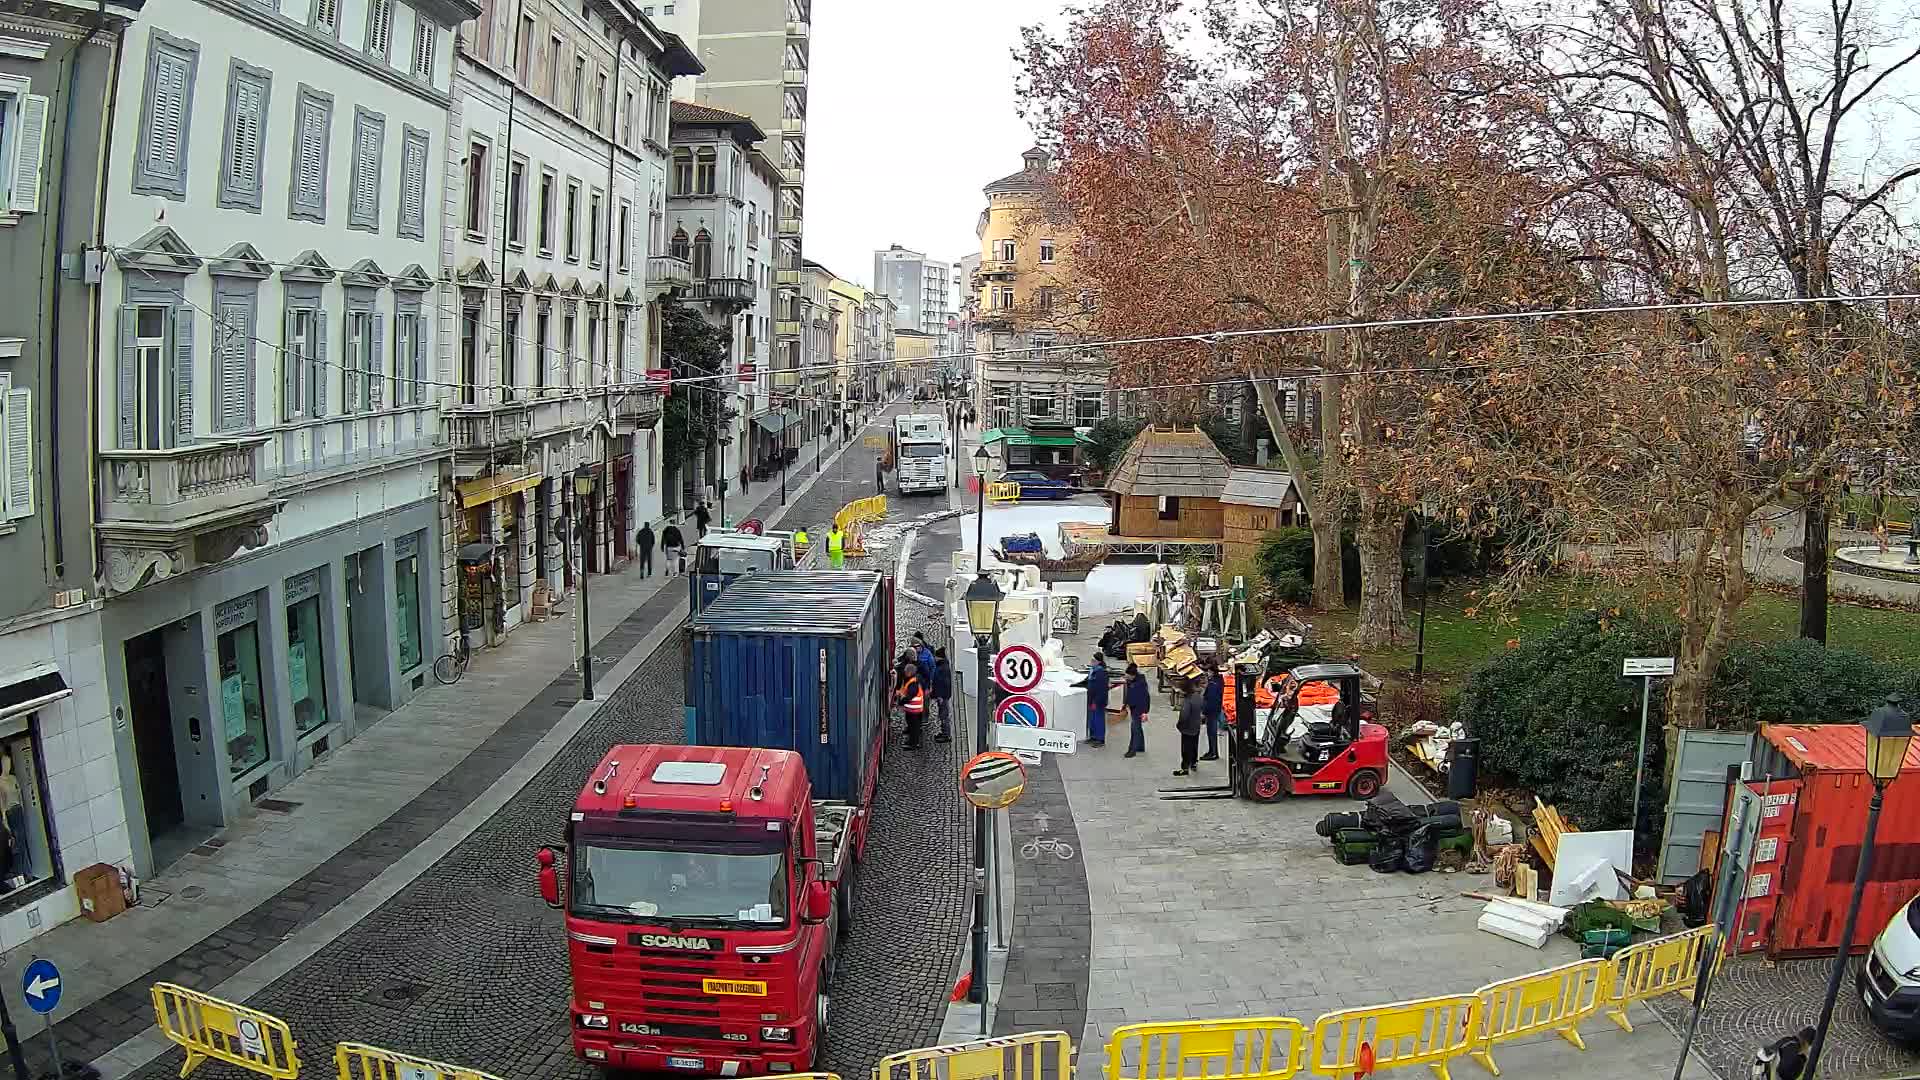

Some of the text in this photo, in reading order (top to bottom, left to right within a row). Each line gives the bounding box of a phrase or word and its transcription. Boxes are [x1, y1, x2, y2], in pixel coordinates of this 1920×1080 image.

[1006, 658, 1033, 680] 30
[1038, 738, 1070, 749] Dante
[641, 934, 711, 950] SCANIA
